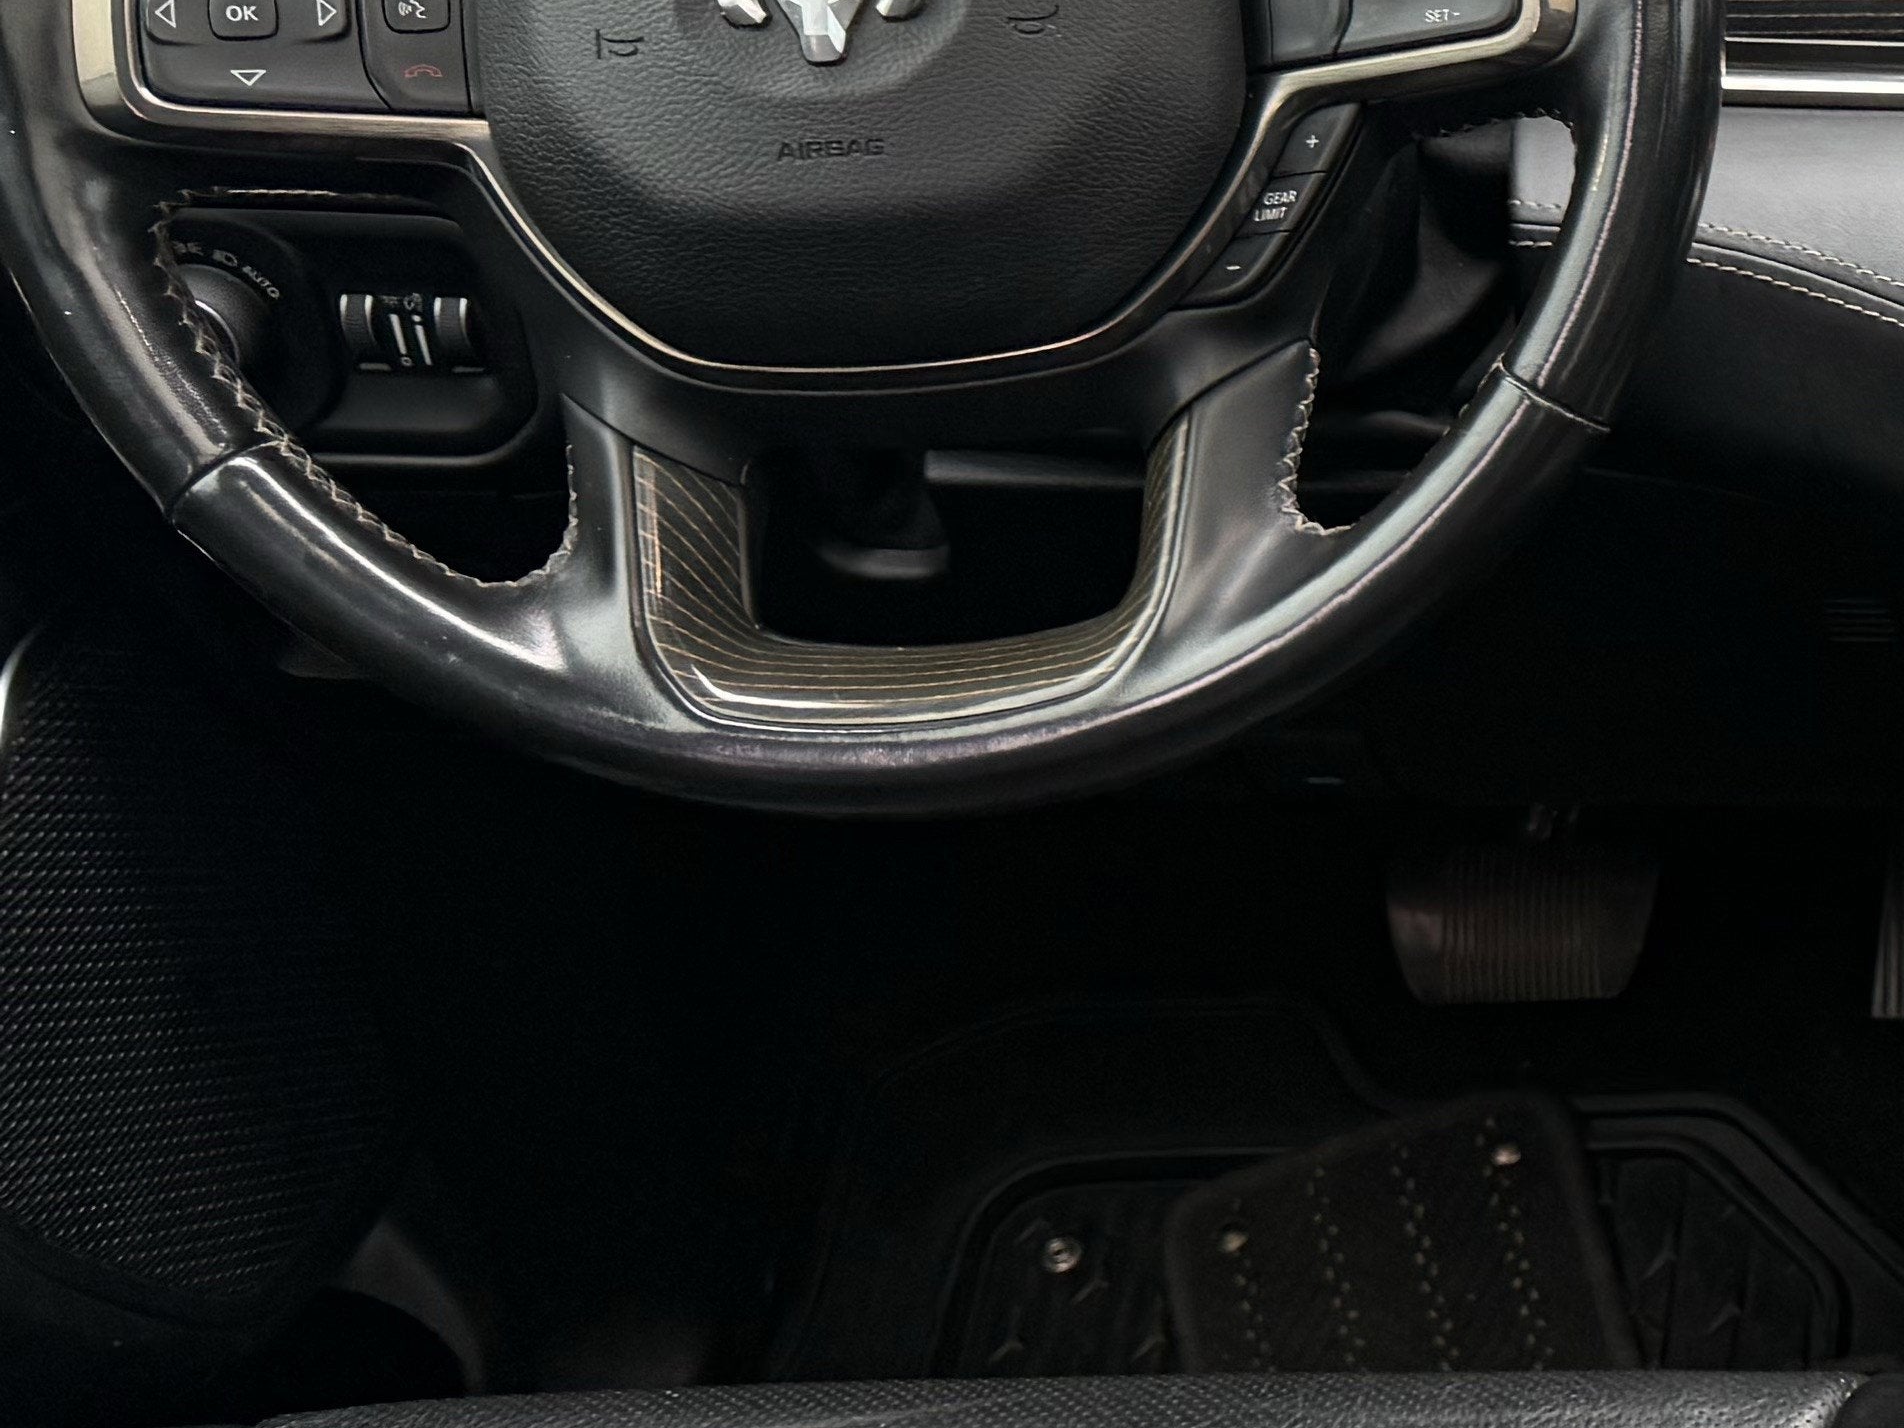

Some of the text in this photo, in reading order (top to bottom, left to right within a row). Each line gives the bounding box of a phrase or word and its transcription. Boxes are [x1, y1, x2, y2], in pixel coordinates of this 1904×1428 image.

[225, 4, 259, 22] OK
[776, 137, 886, 162] AIRBAG
[1263, 189, 1298, 206] GEAR
[1254, 205, 1288, 222] LIMIT
